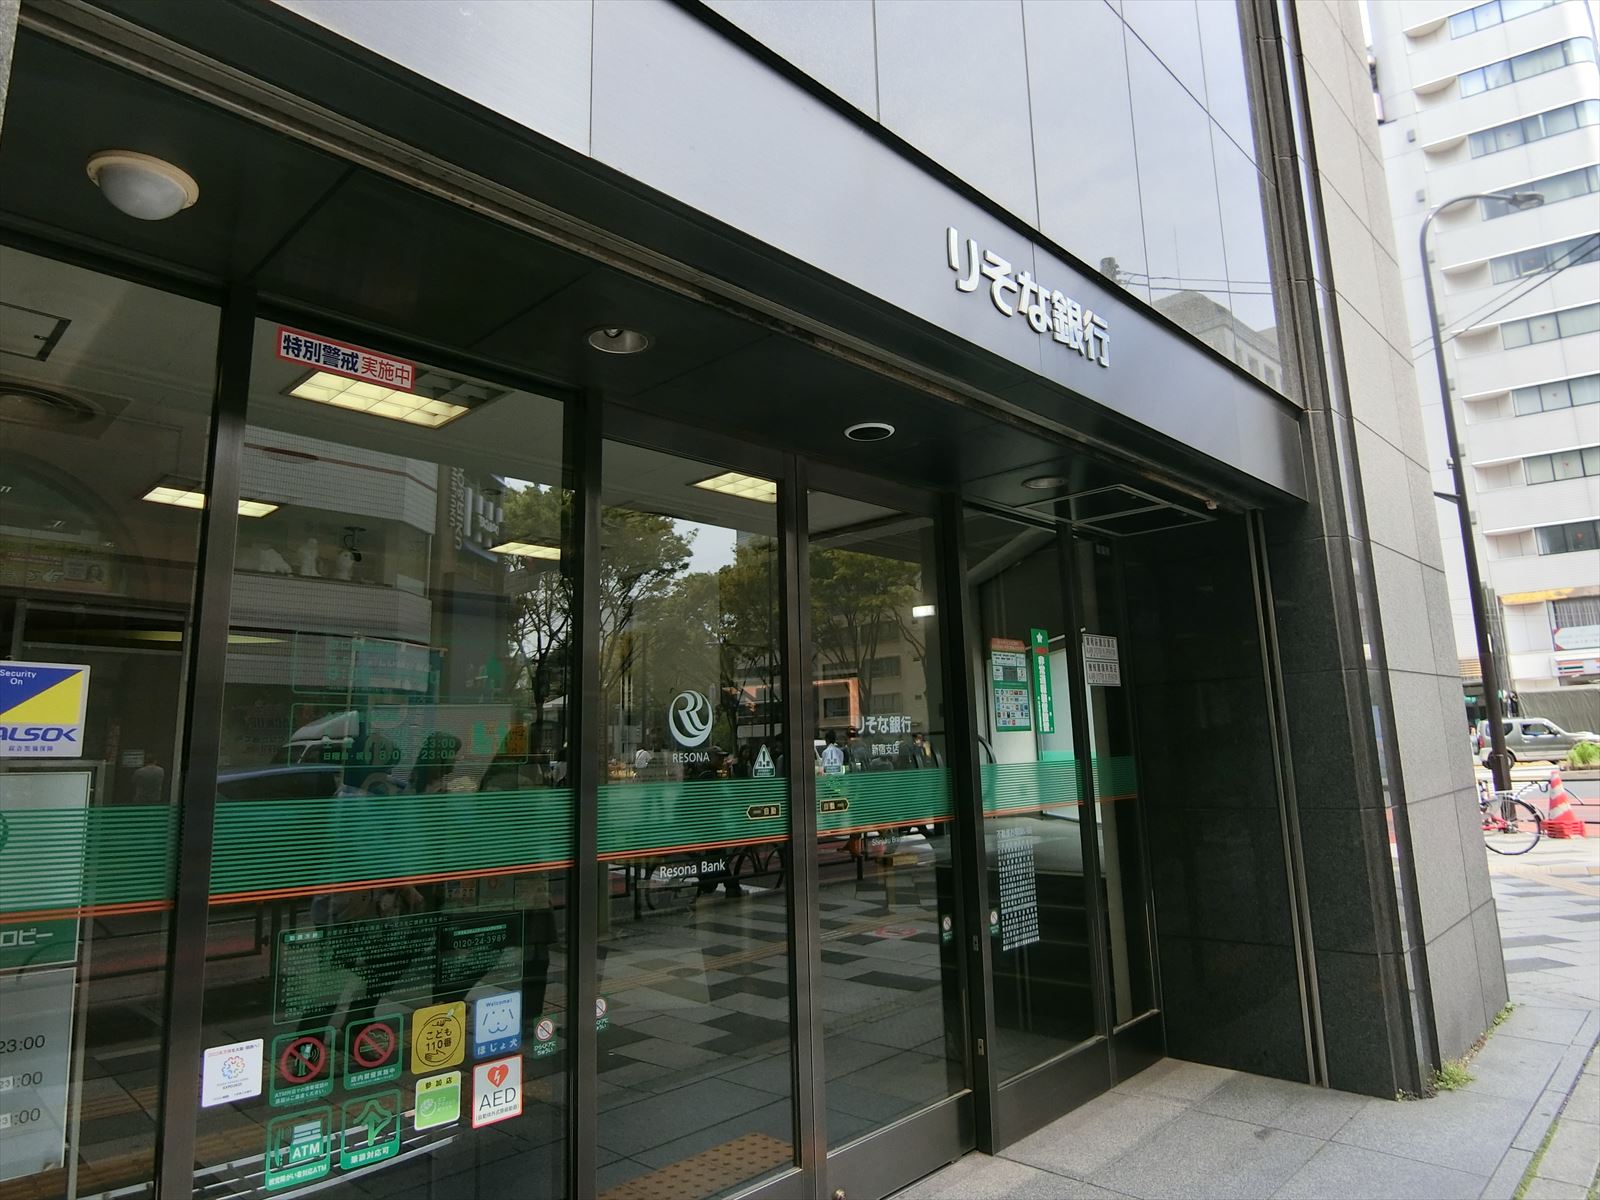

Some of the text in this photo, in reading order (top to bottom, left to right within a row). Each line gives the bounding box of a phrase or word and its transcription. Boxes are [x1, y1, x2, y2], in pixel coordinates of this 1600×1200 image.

[946, 226, 1111, 368] りそな銀行
[0, 669, 37, 679] Security
[10, 678, 24, 686] On
[871, 742, 900, 756] 新宿支店
[672, 751, 711, 764] RESONA
[660, 858, 726, 879] Resona Bank
[0, 928, 54, 947] ロビー
[452, 934, 507, 949] 0120-24-3989
[425, 1028, 452, 1041] こども
[0, 1034, 46, 1054] 23:00
[425, 1039, 452, 1052] 110番
[477, 1038, 518, 1056] ほじょ犬
[479, 1087, 517, 1112] AED
[292, 1141, 320, 1160] ATM
